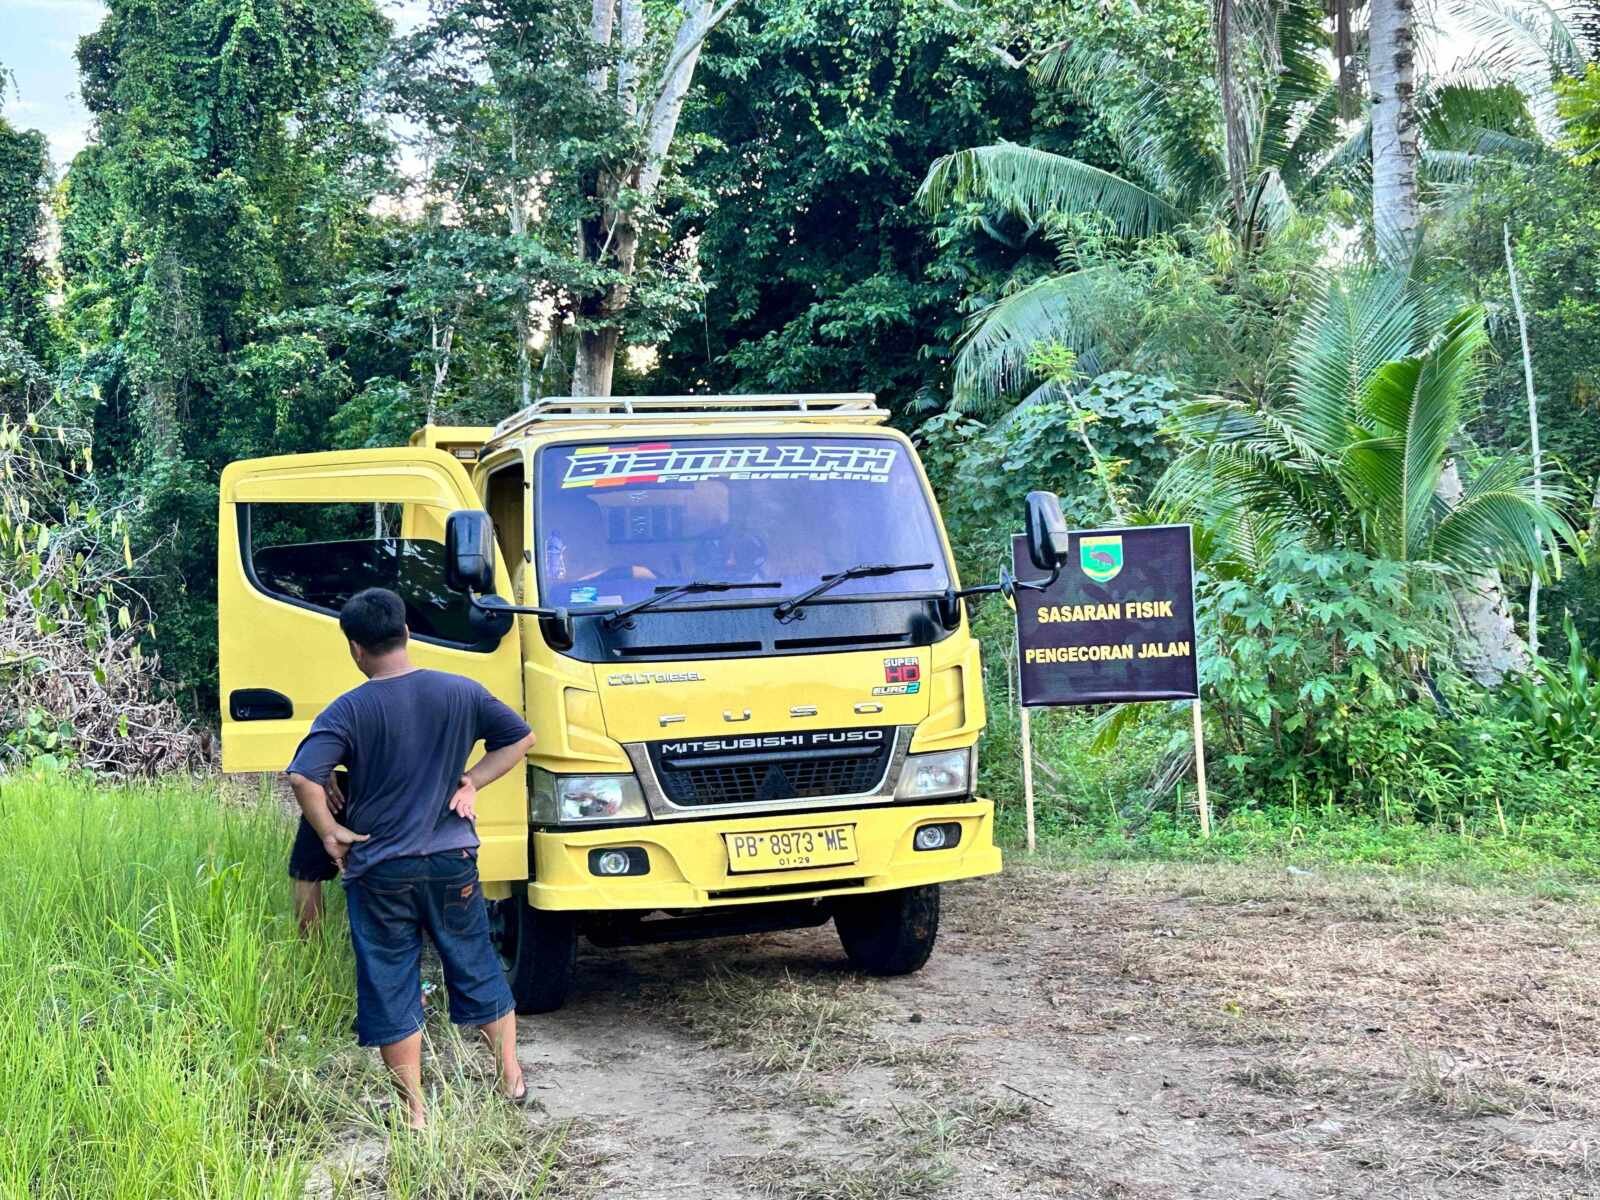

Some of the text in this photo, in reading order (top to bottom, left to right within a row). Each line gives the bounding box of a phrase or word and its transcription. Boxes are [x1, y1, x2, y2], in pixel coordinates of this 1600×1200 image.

[656, 473, 720, 483] For
[1037, 600, 1173, 624] SASARAN FISIK
[884, 657, 919, 667] SUPER
[1025, 641, 1190, 664] PENGECORAN JALAN
[885, 665, 920, 683] HD
[662, 730, 883, 754] MITSUBISHI FUSO
[734, 828, 849, 858] PB 8973 ME
